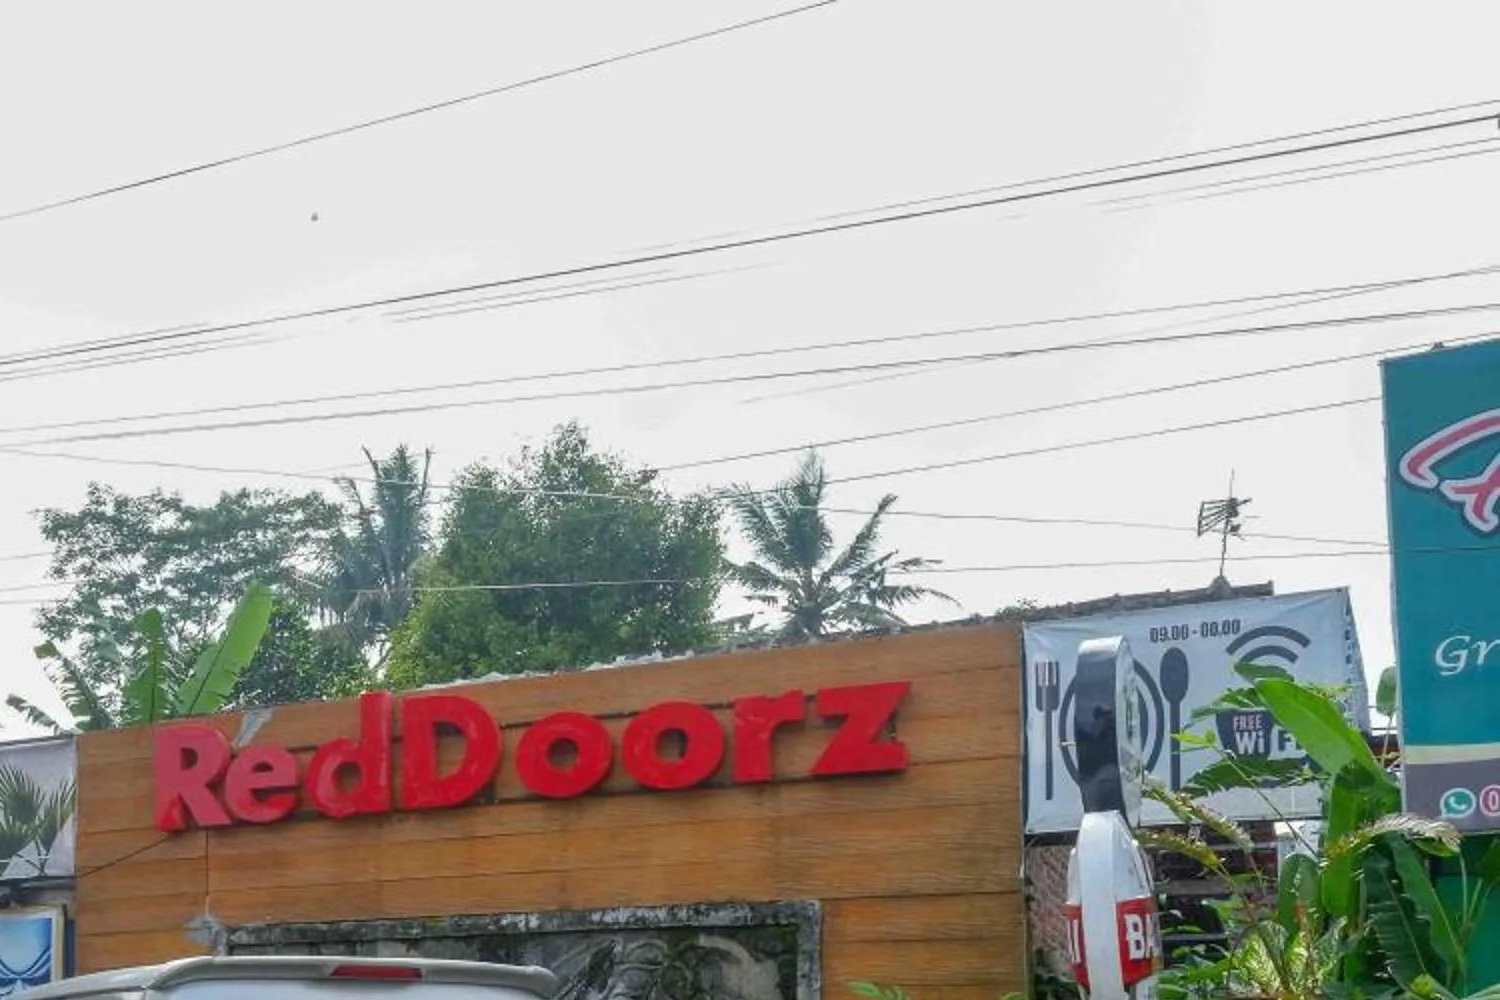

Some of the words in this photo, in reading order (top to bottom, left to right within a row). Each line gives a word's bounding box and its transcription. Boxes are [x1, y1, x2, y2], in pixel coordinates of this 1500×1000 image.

[1149, 624, 1190, 644] 09.00
[1199, 618, 1242, 639] 00.00
[1233, 713, 1262, 731] FREE
[153, 681, 912, 833] RedDoorz
